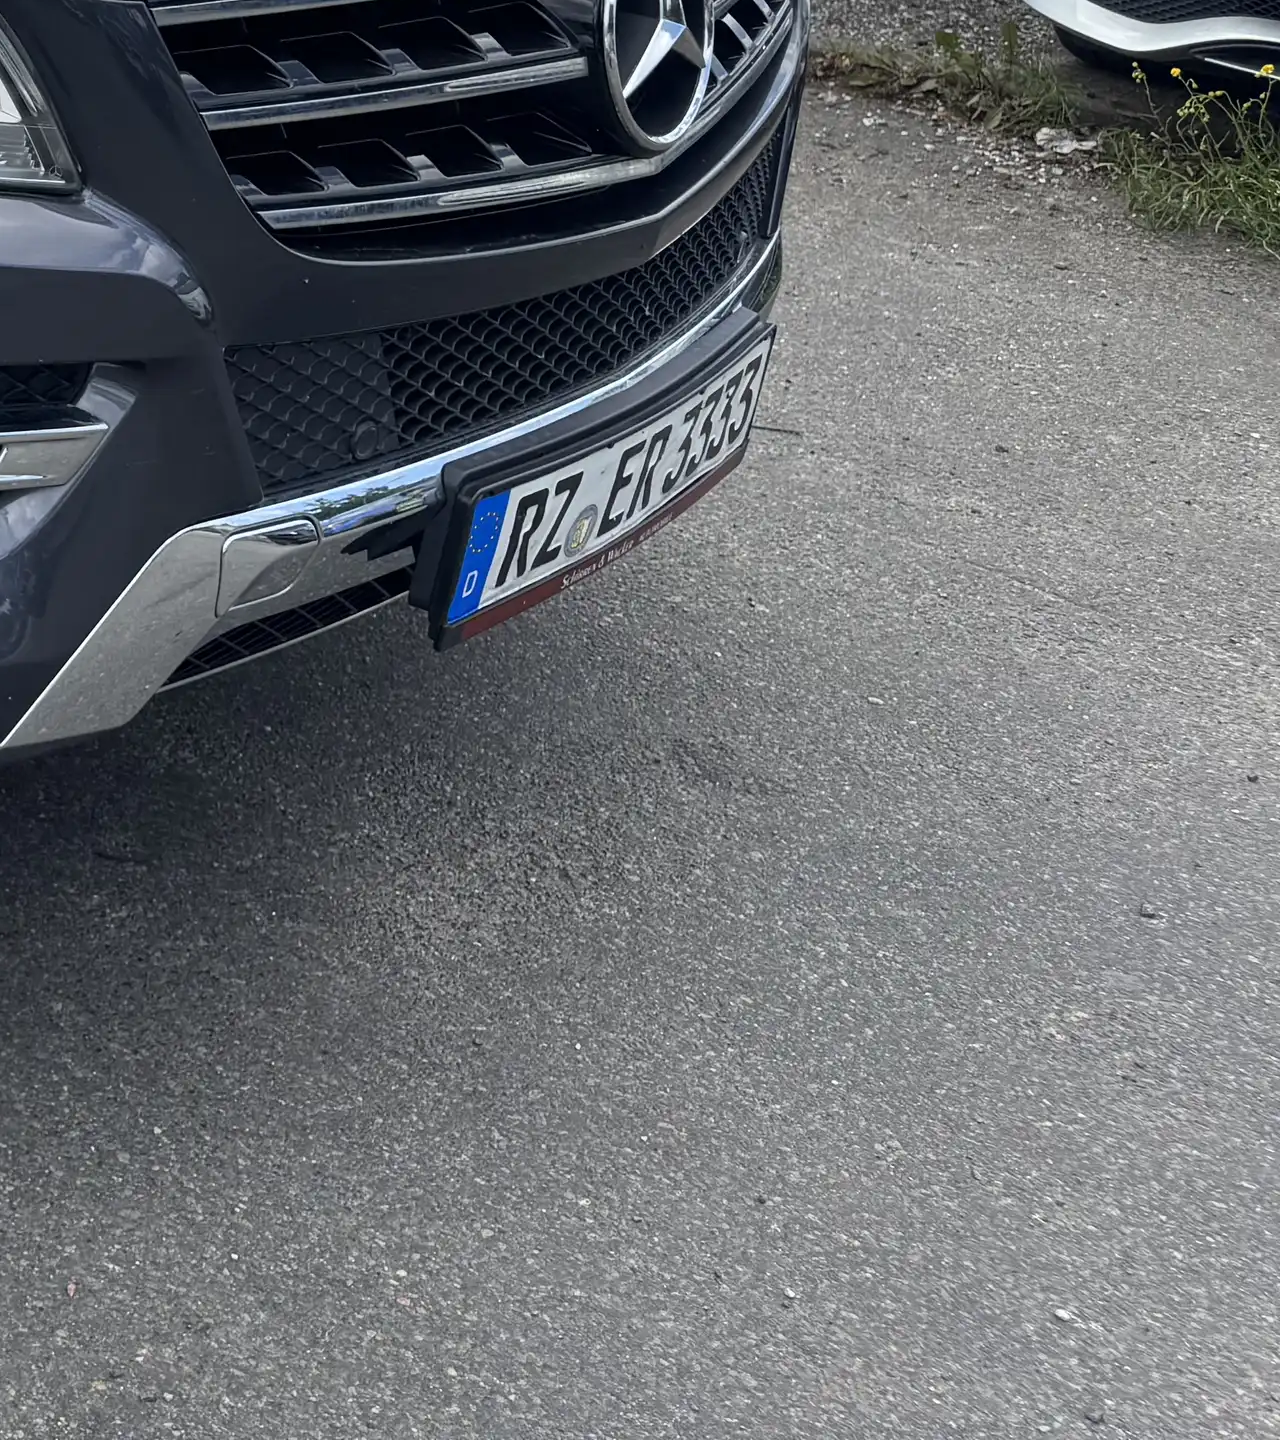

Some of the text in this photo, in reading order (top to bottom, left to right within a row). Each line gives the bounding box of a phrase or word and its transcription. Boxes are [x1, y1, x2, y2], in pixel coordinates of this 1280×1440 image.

[494, 471, 584, 588] RZ
[597, 424, 674, 537] ER
[662, 353, 762, 494] 3333
[461, 569, 478, 598] D
